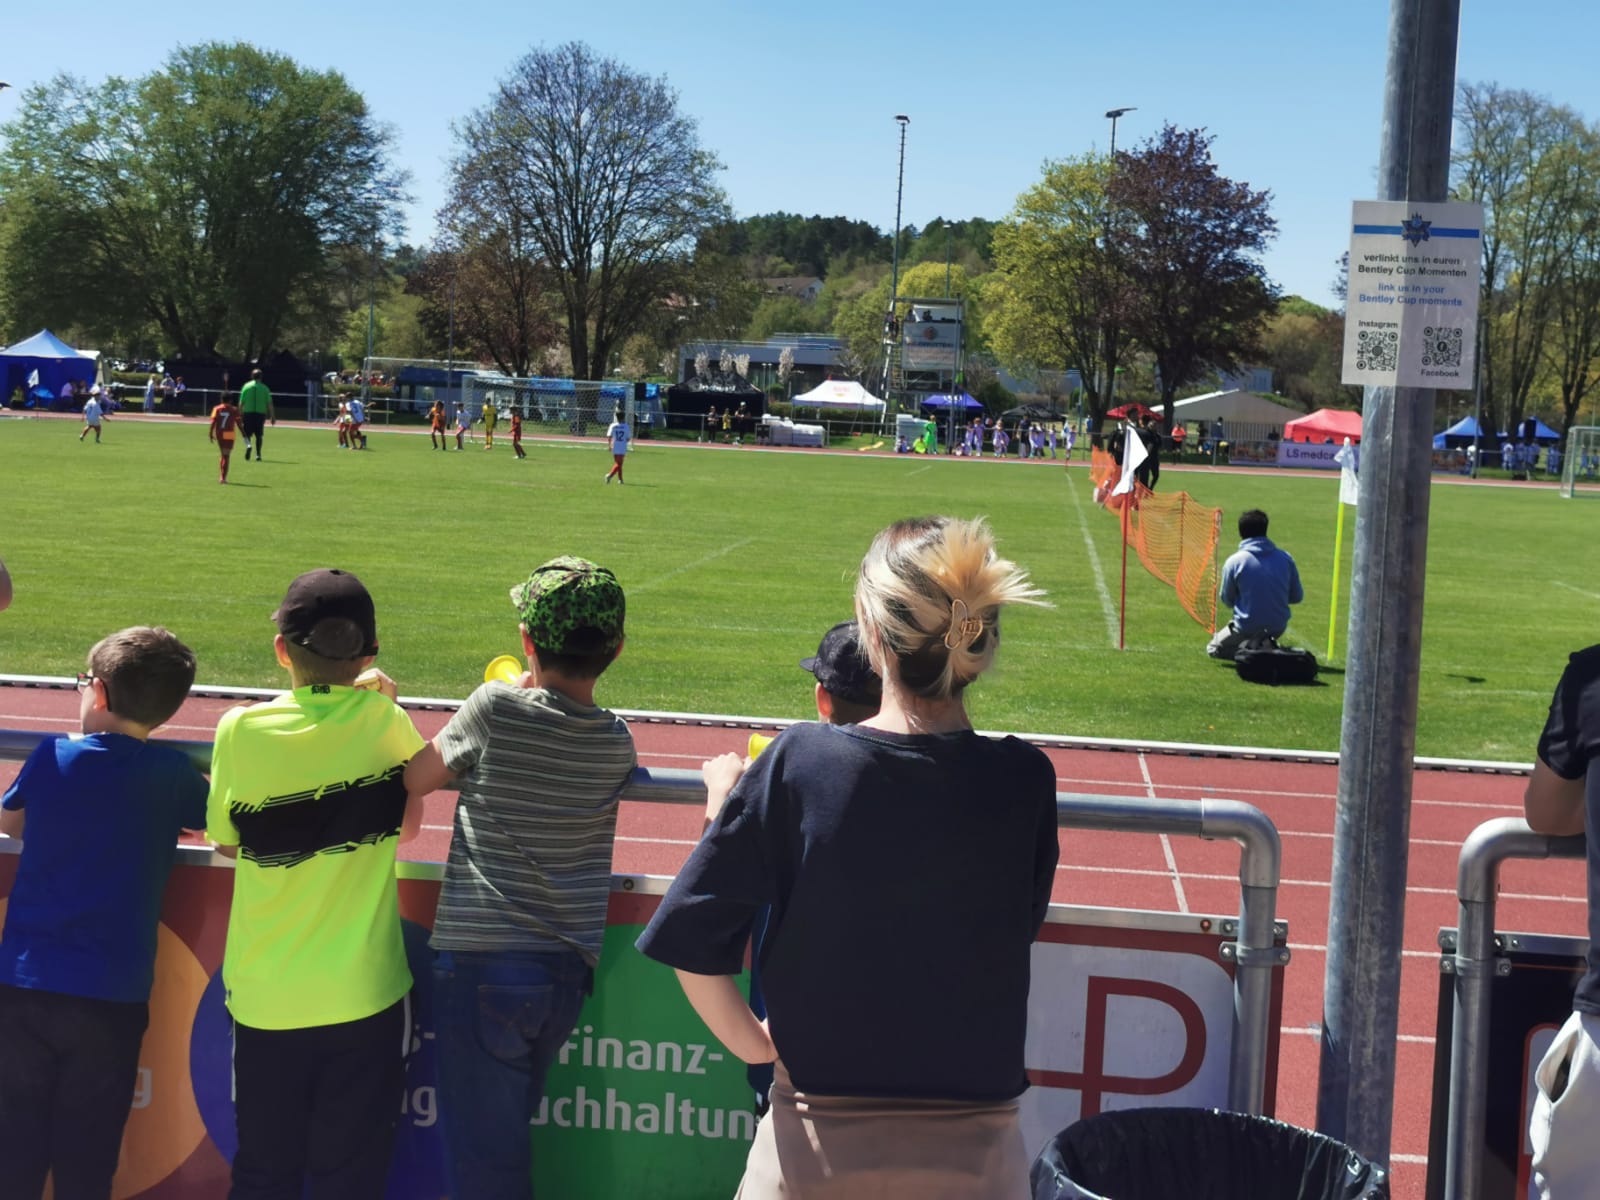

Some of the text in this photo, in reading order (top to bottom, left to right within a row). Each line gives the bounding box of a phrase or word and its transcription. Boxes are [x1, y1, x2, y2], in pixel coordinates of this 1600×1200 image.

[1401, 255, 1420, 263] uns
[1422, 255, 1431, 264] in
[1358, 264, 1467, 277] Bentley Cup Momenten
[1378, 282, 1395, 291] link
[1412, 283, 1421, 292] in
[1423, 285, 1445, 294] your
[1359, 293, 1463, 306] Bentley Cup moments
[1358, 319, 1399, 329] Instagram
[1420, 368, 1460, 377] Facebook
[220, 411, 230, 429] 7
[615, 430, 625, 442] 12
[1286, 448, 1299, 458] LS
